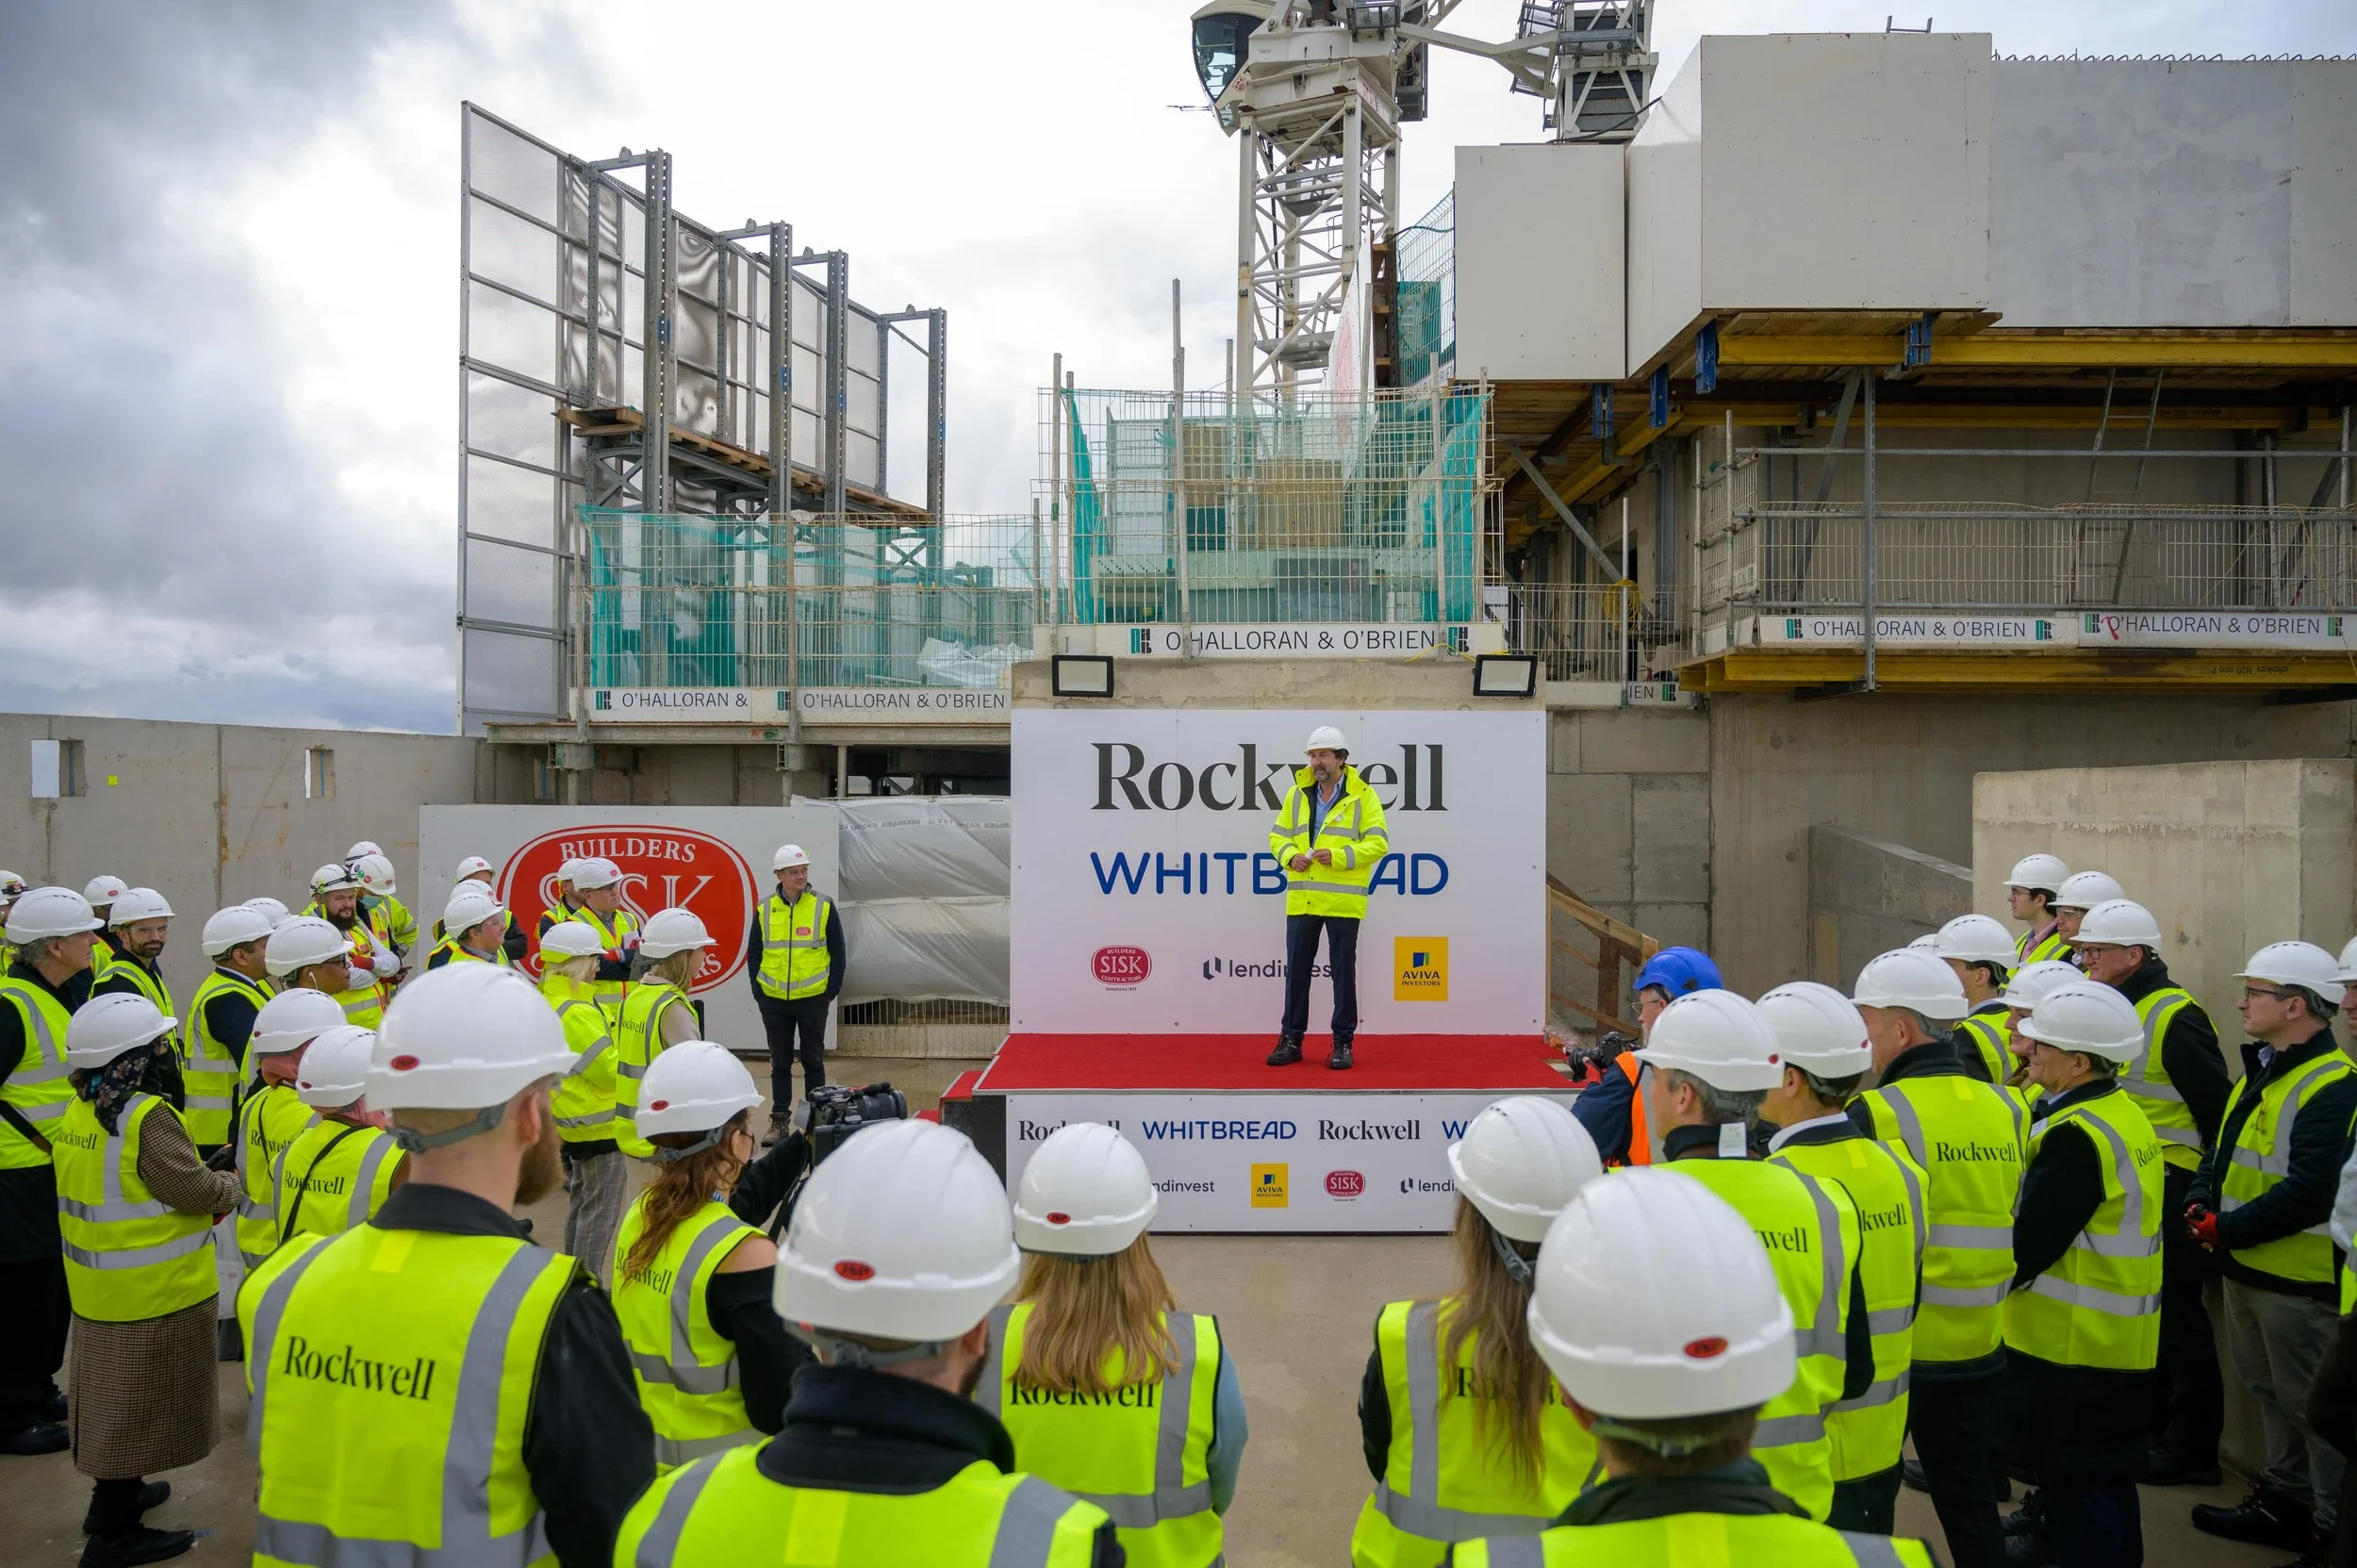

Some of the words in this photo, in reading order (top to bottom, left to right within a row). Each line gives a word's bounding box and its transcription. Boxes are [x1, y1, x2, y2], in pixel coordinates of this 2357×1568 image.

[1814, 620, 1925, 636] O'HALORAN
[1933, 621, 1947, 636] &
[1953, 621, 2025, 637] O'BRIEN
[2109, 616, 2221, 634] O'HALLORAN
[2228, 618, 2241, 633] &
[2247, 618, 2320, 635] O'BRIEN
[1165, 630, 1309, 652] OHALLORAN
[1317, 631, 1335, 649] &
[1343, 629, 1436, 650] O'BRIEN
[622, 692, 729, 709] O'HALLORAN
[734, 693, 750, 708] &
[803, 692, 911, 709] O'HALLORAN
[916, 693, 931, 708] &
[935, 693, 1006, 709] O'BRIEN
[1091, 743, 1449, 812] Rockell
[559, 837, 696, 863] BUILDERS
[1090, 851, 1450, 896] WHITBAD
[1100, 955, 1143, 974] SISK
[1228, 959, 1332, 978] lendies
[1402, 970, 1441, 980] AVIVA
[1142, 1120, 1297, 1140] WHITBREAD
[1318, 1119, 1421, 1141] Rockwell
[1935, 1141, 2017, 1163] Rockwell
[1151, 1180, 1215, 1193] ndinvest
[1329, 1177, 1360, 1190] SISK
[1418, 1179, 1455, 1192] lendi
[1861, 1203, 1907, 1232] kwell
[1755, 1227, 1808, 1253] well
[283, 1334, 437, 1401] Rockwell
